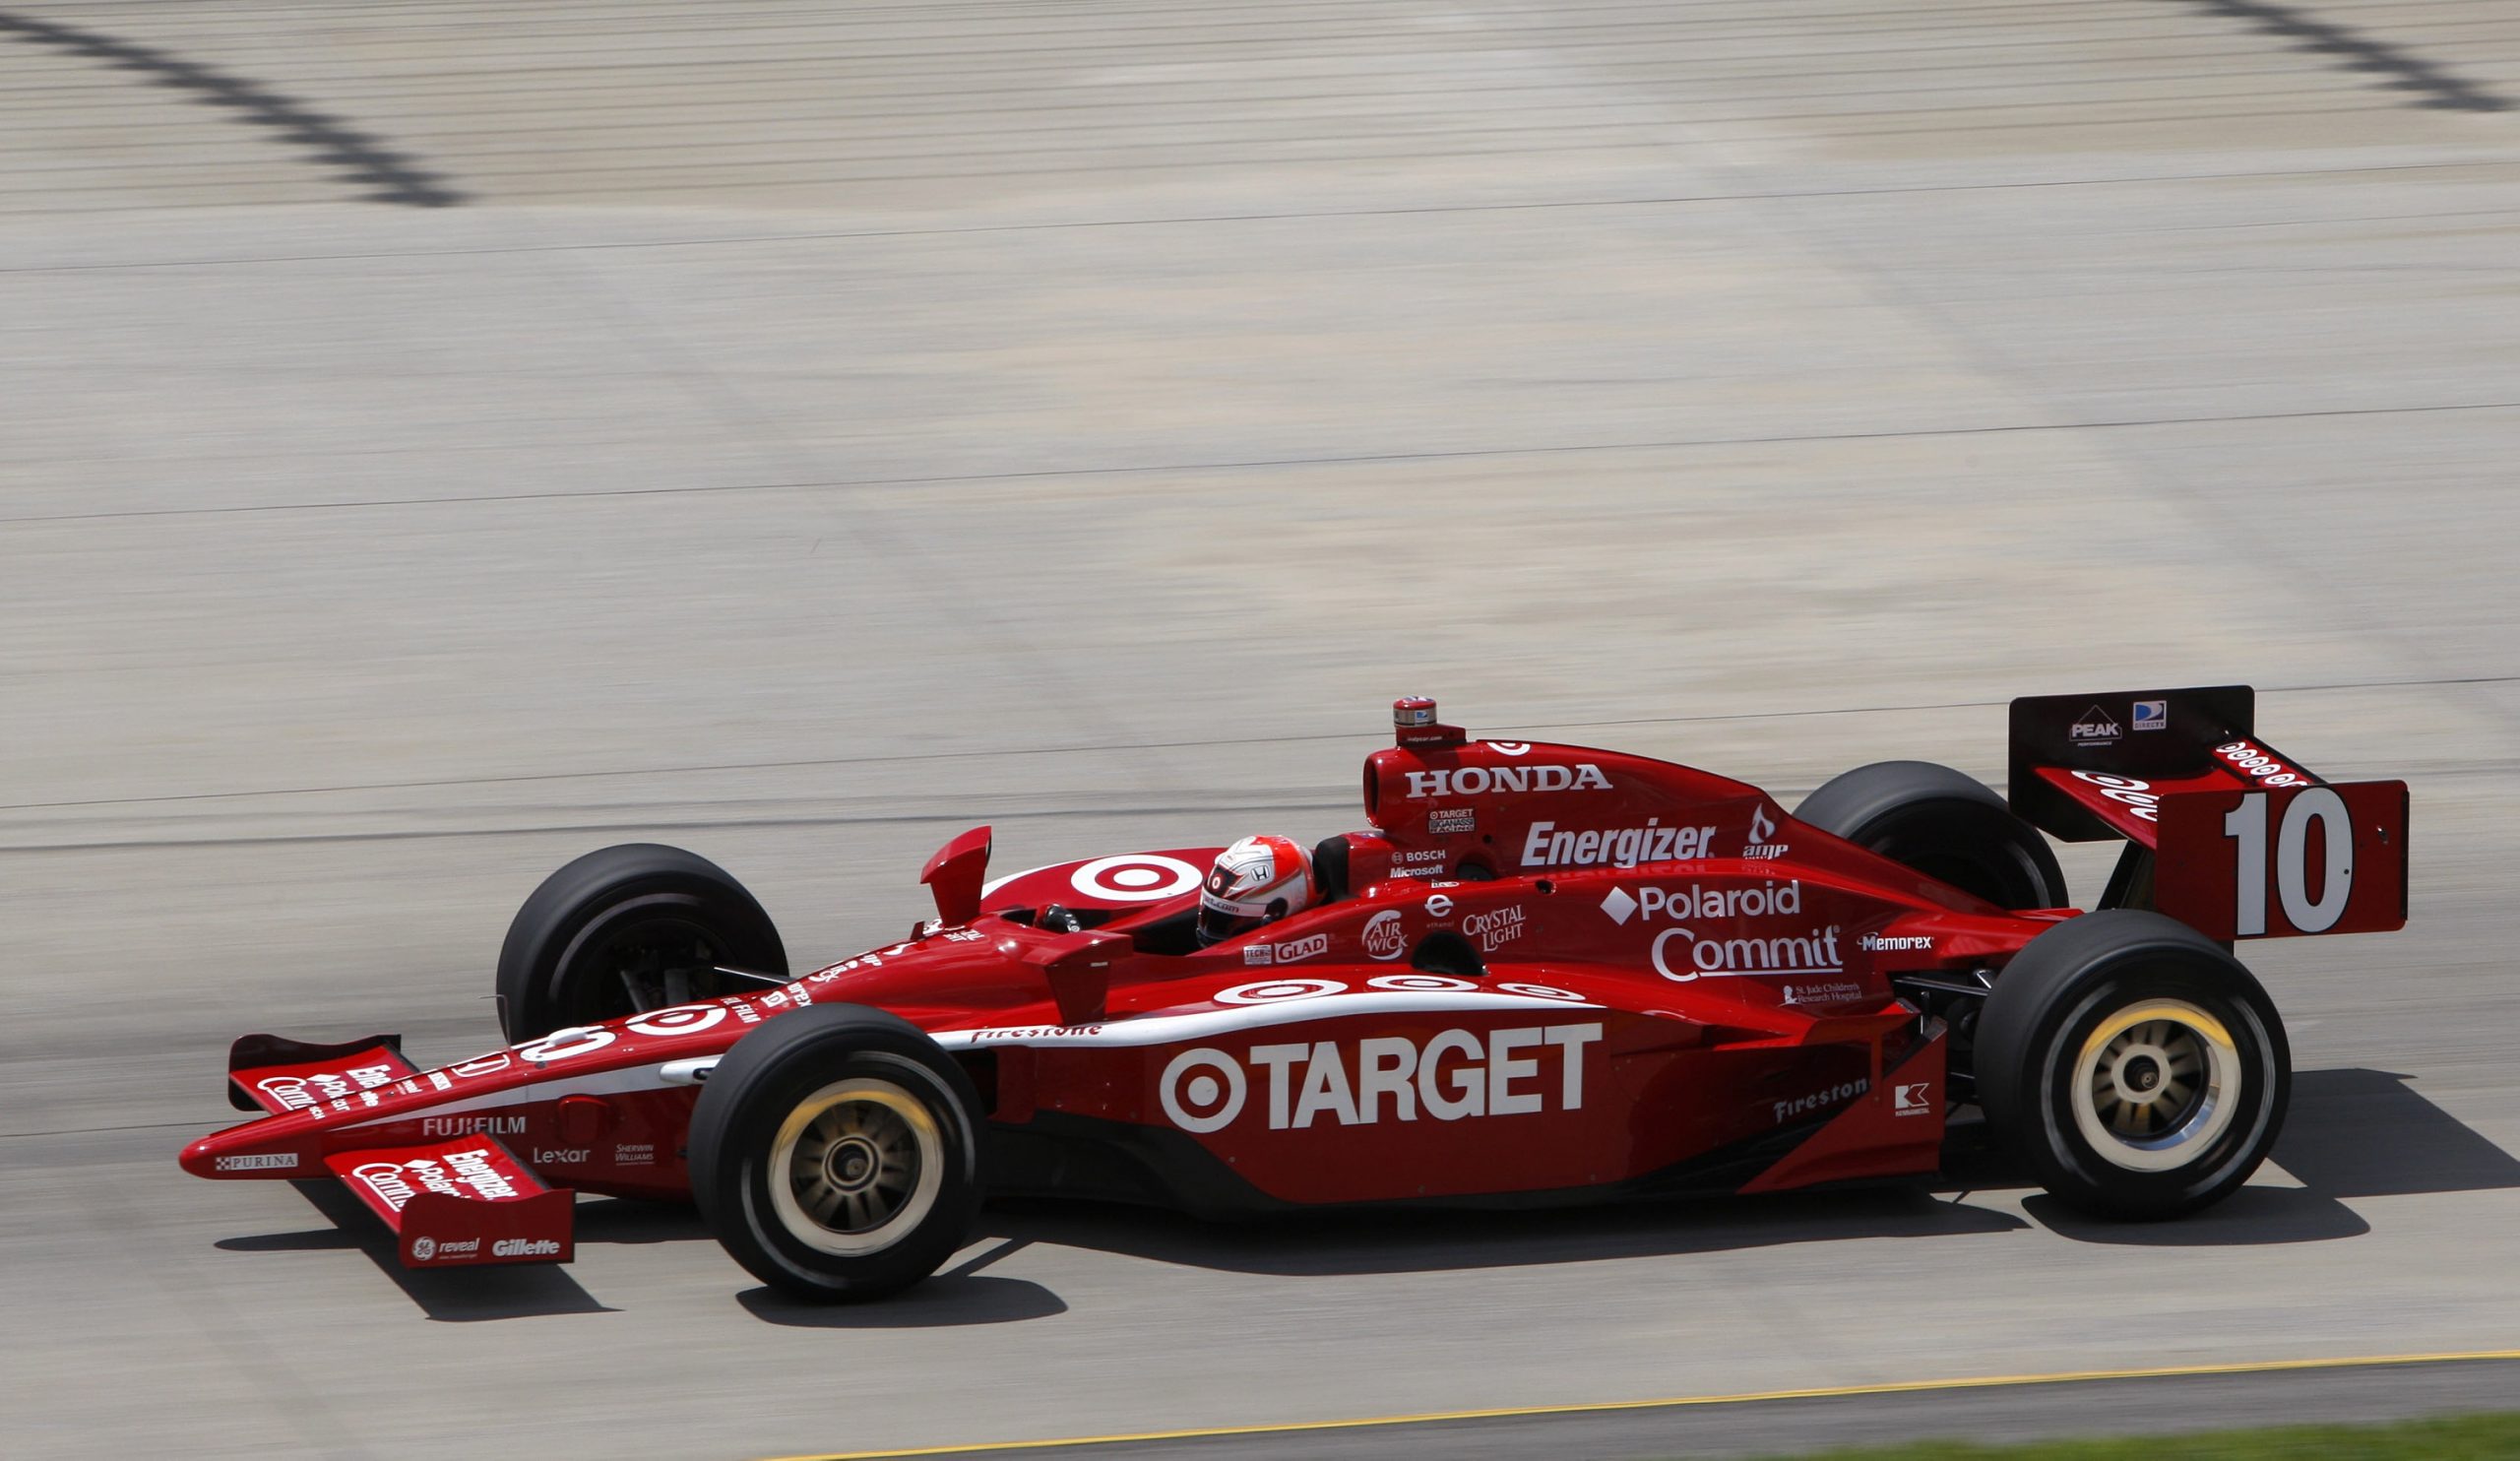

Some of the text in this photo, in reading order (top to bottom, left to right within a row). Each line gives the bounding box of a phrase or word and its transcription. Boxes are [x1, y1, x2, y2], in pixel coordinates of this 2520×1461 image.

[2072, 723, 2119, 737] PEAK
[1405, 763, 1613, 798] HONDA
[1439, 808, 1474, 819] TARGET
[1520, 817, 1718, 869] Energizer
[1742, 844, 1790, 859] amp
[1406, 850, 1447, 862] BOSCH
[2224, 787, 2355, 936] 10
[1389, 864, 1444, 879] Microsoft
[1639, 879, 1800, 921] Polaroid
[1463, 905, 1527, 935] CRYSTAL
[1366, 934, 1409, 953] WICK
[1482, 923, 1524, 952] LIGHT
[1861, 935, 1933, 952] Memorex
[1279, 937, 1325, 961] GLAD
[1652, 924, 1844, 983] Commit
[788, 981, 813, 1008] orex
[1796, 990, 1862, 1003] Research Hospital
[970, 1025, 1102, 1045] Firestone
[1249, 1022, 1604, 1131] TARGET
[1773, 1077, 1869, 1124] Fireston
[422, 1115, 527, 1137] FUJIFILM
[232, 1156, 295, 1170] PURINA
[534, 1147, 591, 1165] Lexar
[614, 1153, 655, 1163] WILLIAMS
[443, 1149, 519, 1201] Energizer
[438, 1237, 481, 1253] reveal
[492, 1238, 561, 1257] Gillette
